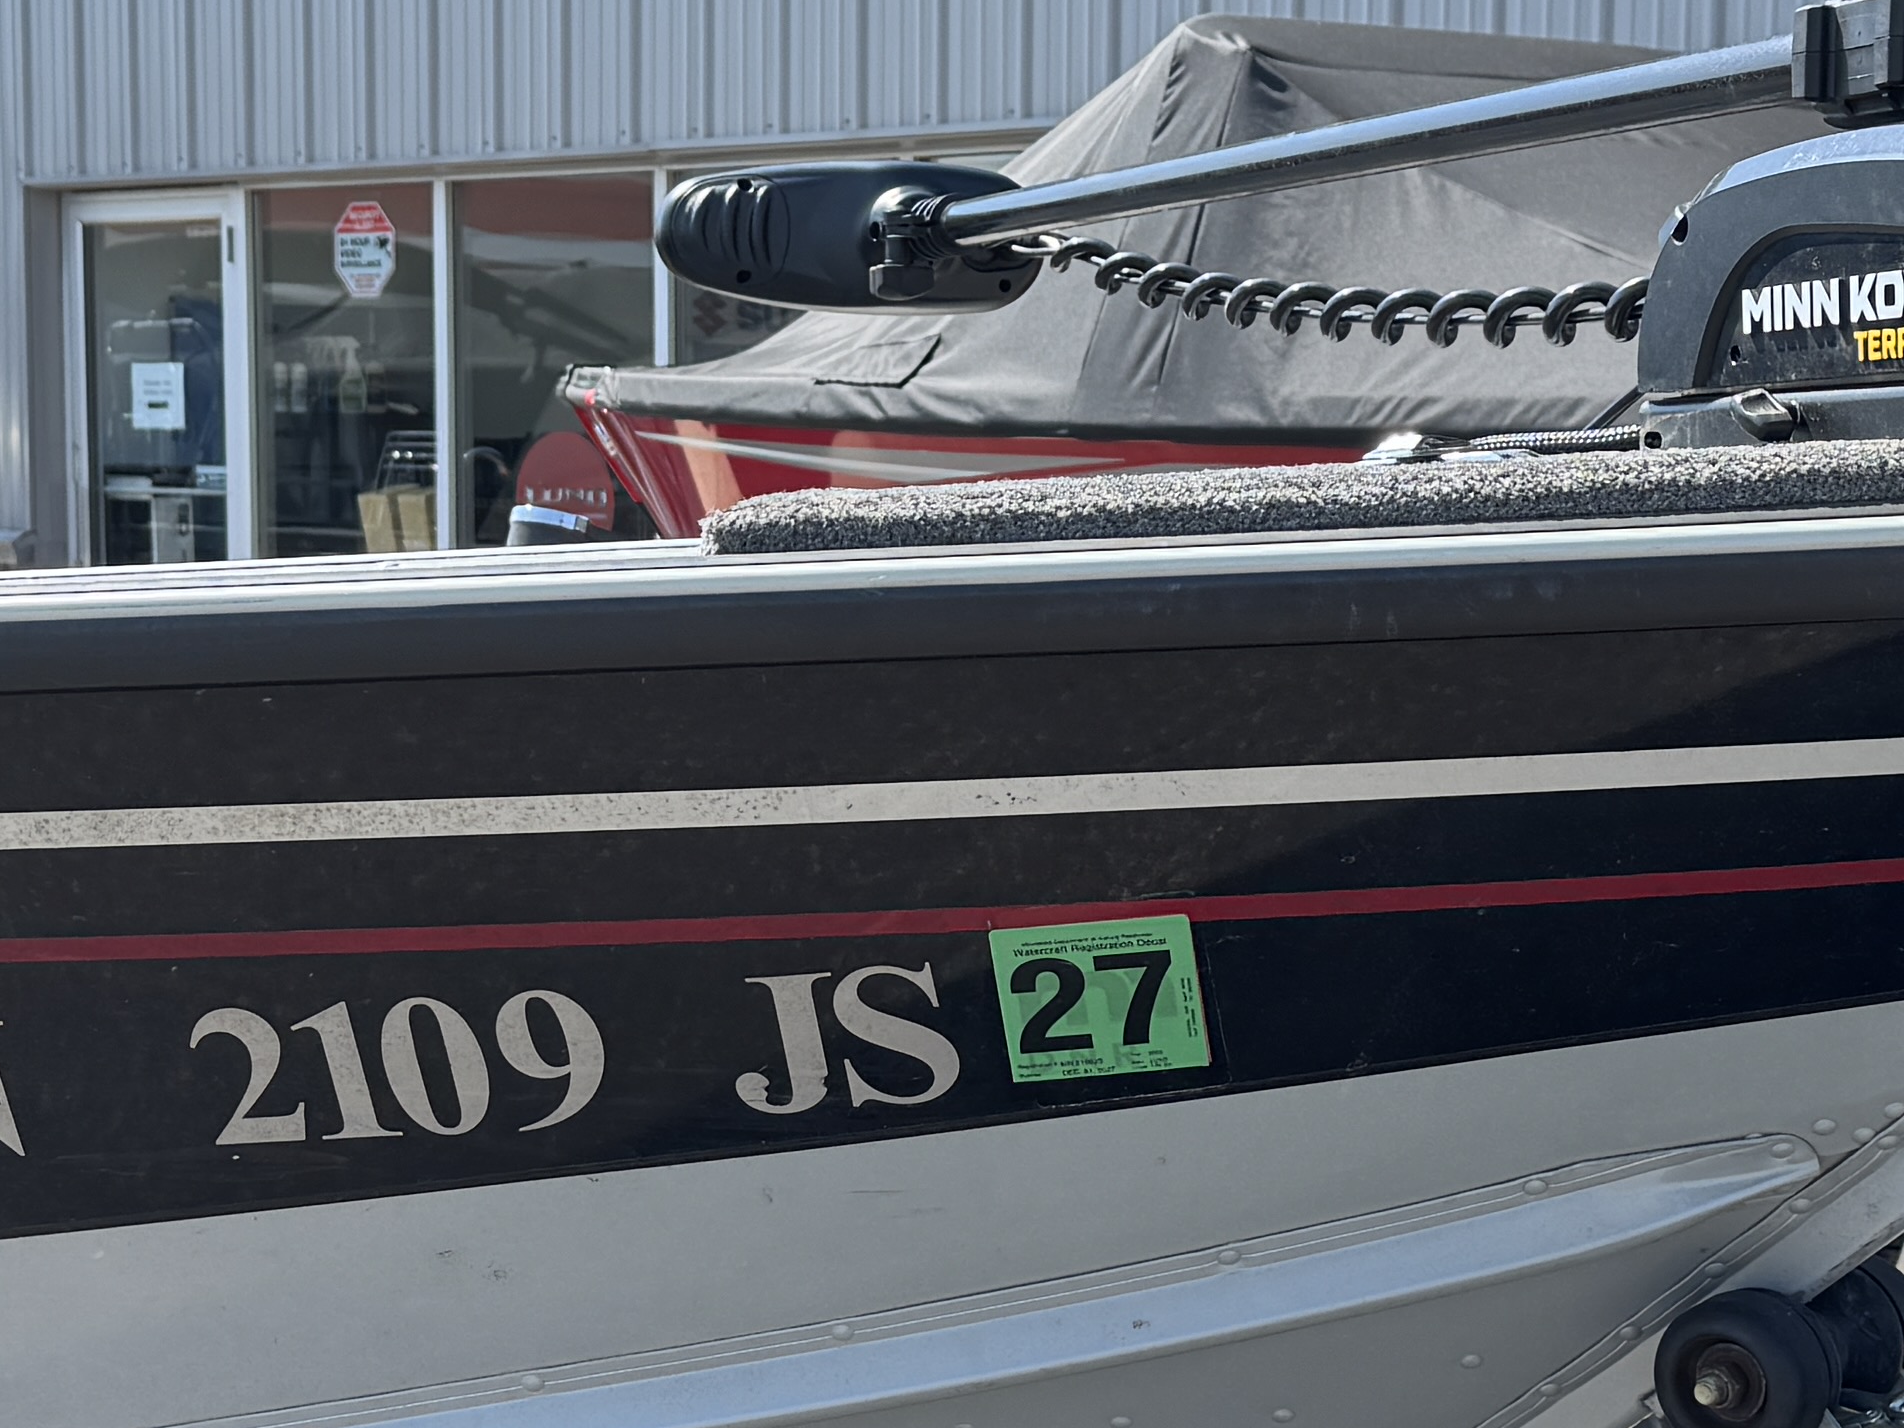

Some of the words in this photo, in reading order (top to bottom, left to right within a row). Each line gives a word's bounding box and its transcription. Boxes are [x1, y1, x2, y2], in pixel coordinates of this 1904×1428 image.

[1741, 278, 1840, 335] MINN
[188, 989, 605, 1148] 2109
[735, 961, 960, 1115] JS
[1010, 949, 1172, 1055] 27
